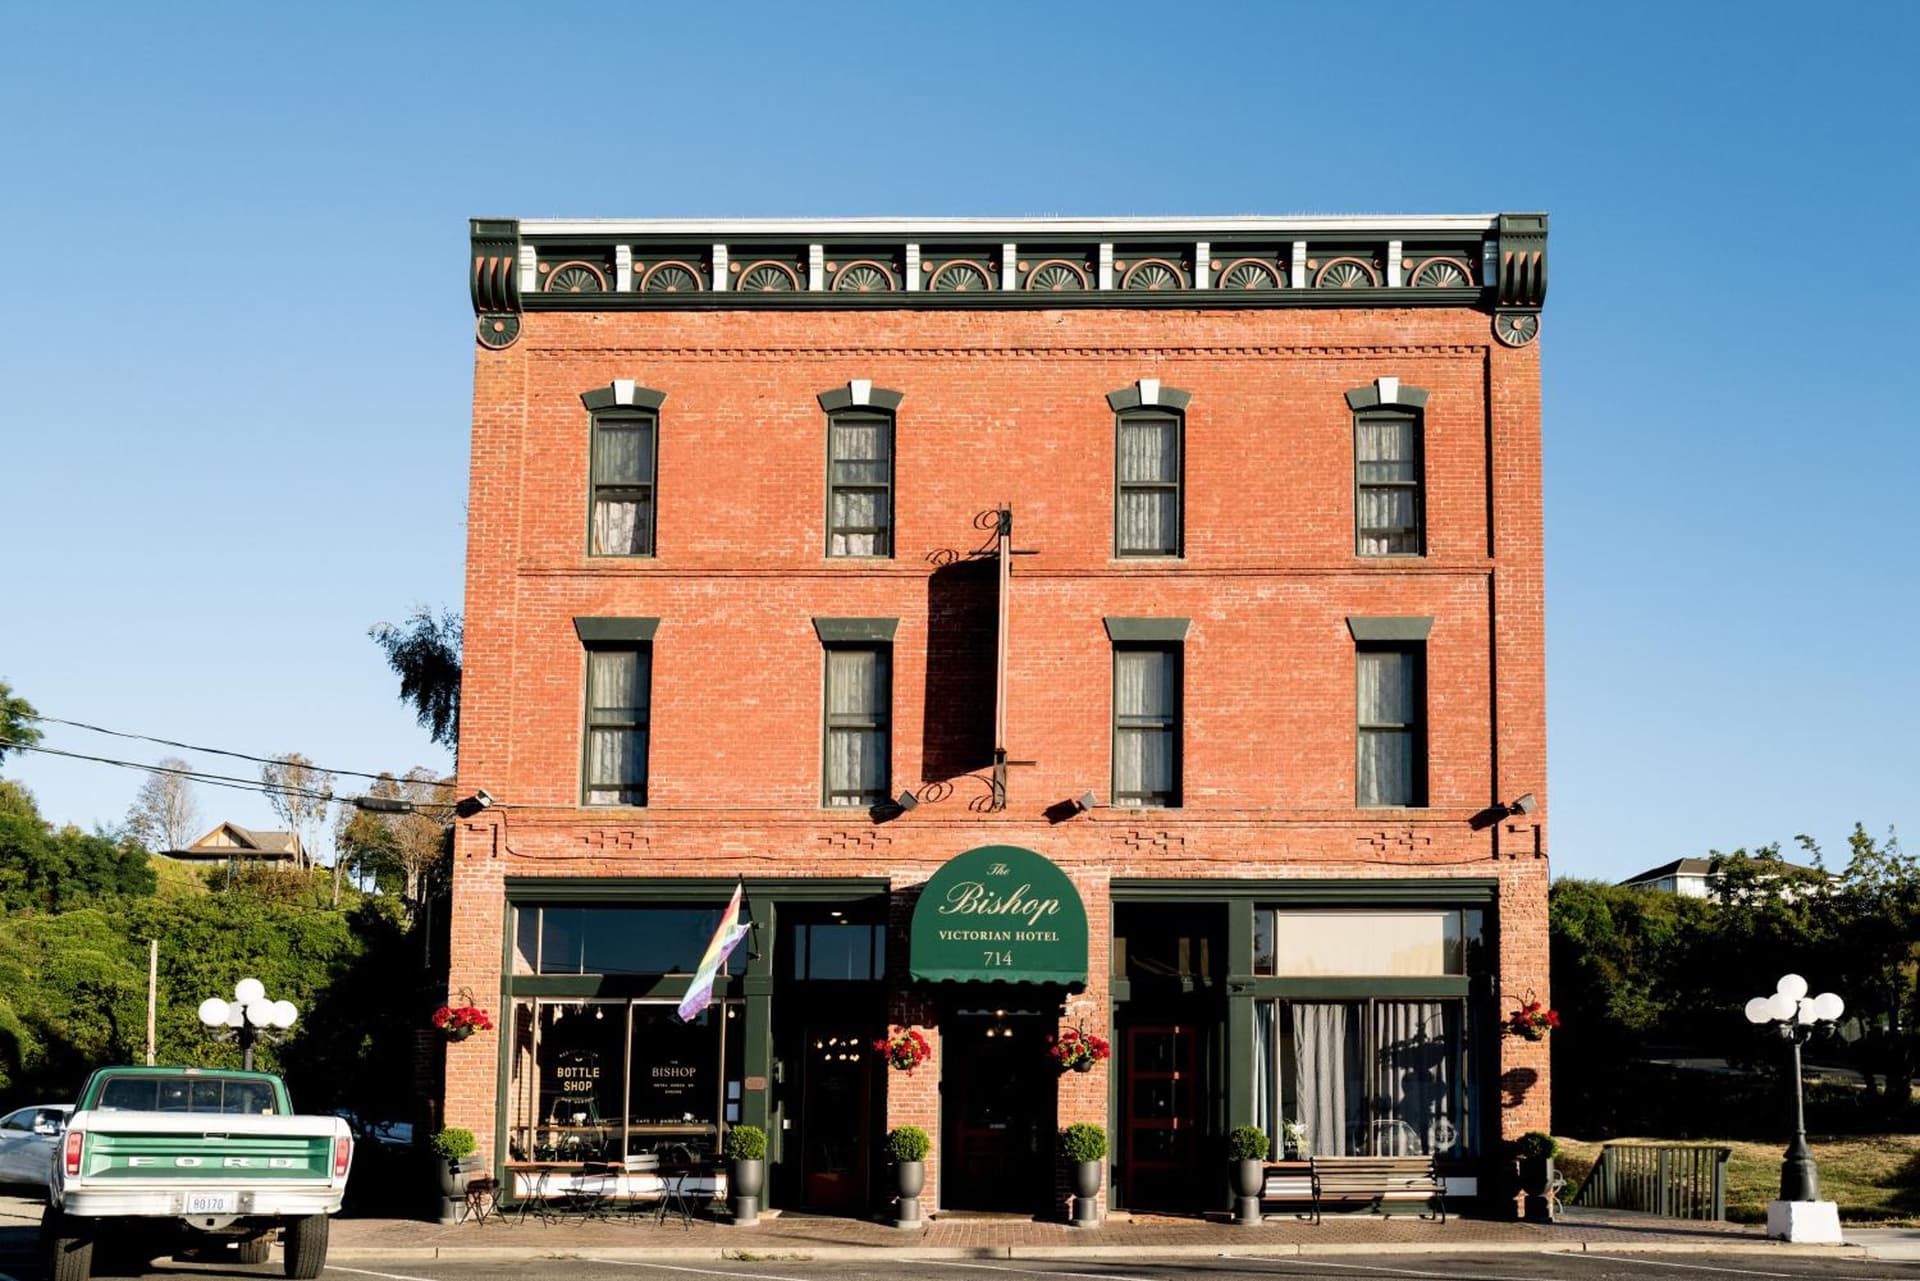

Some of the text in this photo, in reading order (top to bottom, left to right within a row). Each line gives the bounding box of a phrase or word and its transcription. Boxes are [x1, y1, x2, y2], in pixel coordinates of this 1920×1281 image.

[986, 863, 1010, 876] The
[938, 881, 1060, 926] Bishop
[939, 930, 1059, 942] VICTORIAN HOTEL
[983, 950, 1013, 966] 714
[557, 1066, 600, 1078] BOTTLE
[651, 1066, 697, 1078] BISHOP
[563, 1080, 593, 1092] SHOP
[128, 1156, 297, 1168] FORD
